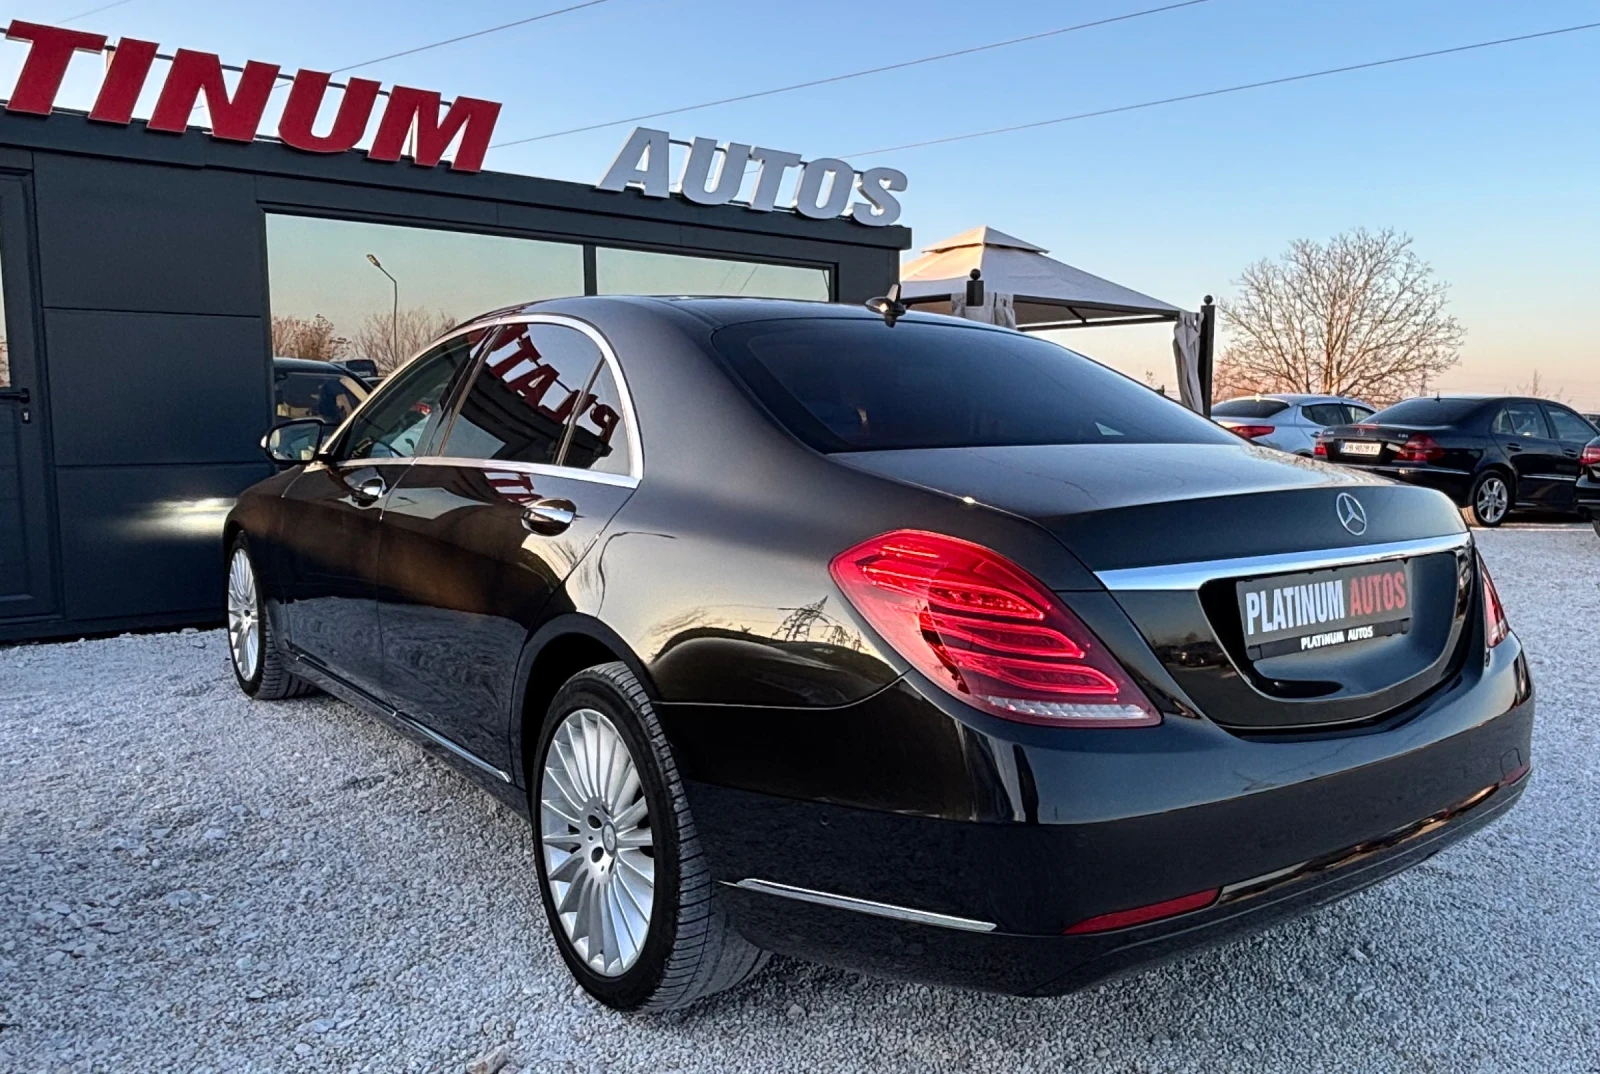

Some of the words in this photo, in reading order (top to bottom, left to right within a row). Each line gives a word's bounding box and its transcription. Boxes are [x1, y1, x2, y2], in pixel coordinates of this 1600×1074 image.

[6, 20, 502, 172] TINUM
[595, 127, 908, 226] AUTOS
[1246, 580, 1345, 635] PLATINUM
[1350, 572, 1407, 616] AUTOS
[1301, 630, 1345, 650] PLATINUM
[1347, 626, 1374, 641] AUTOS
